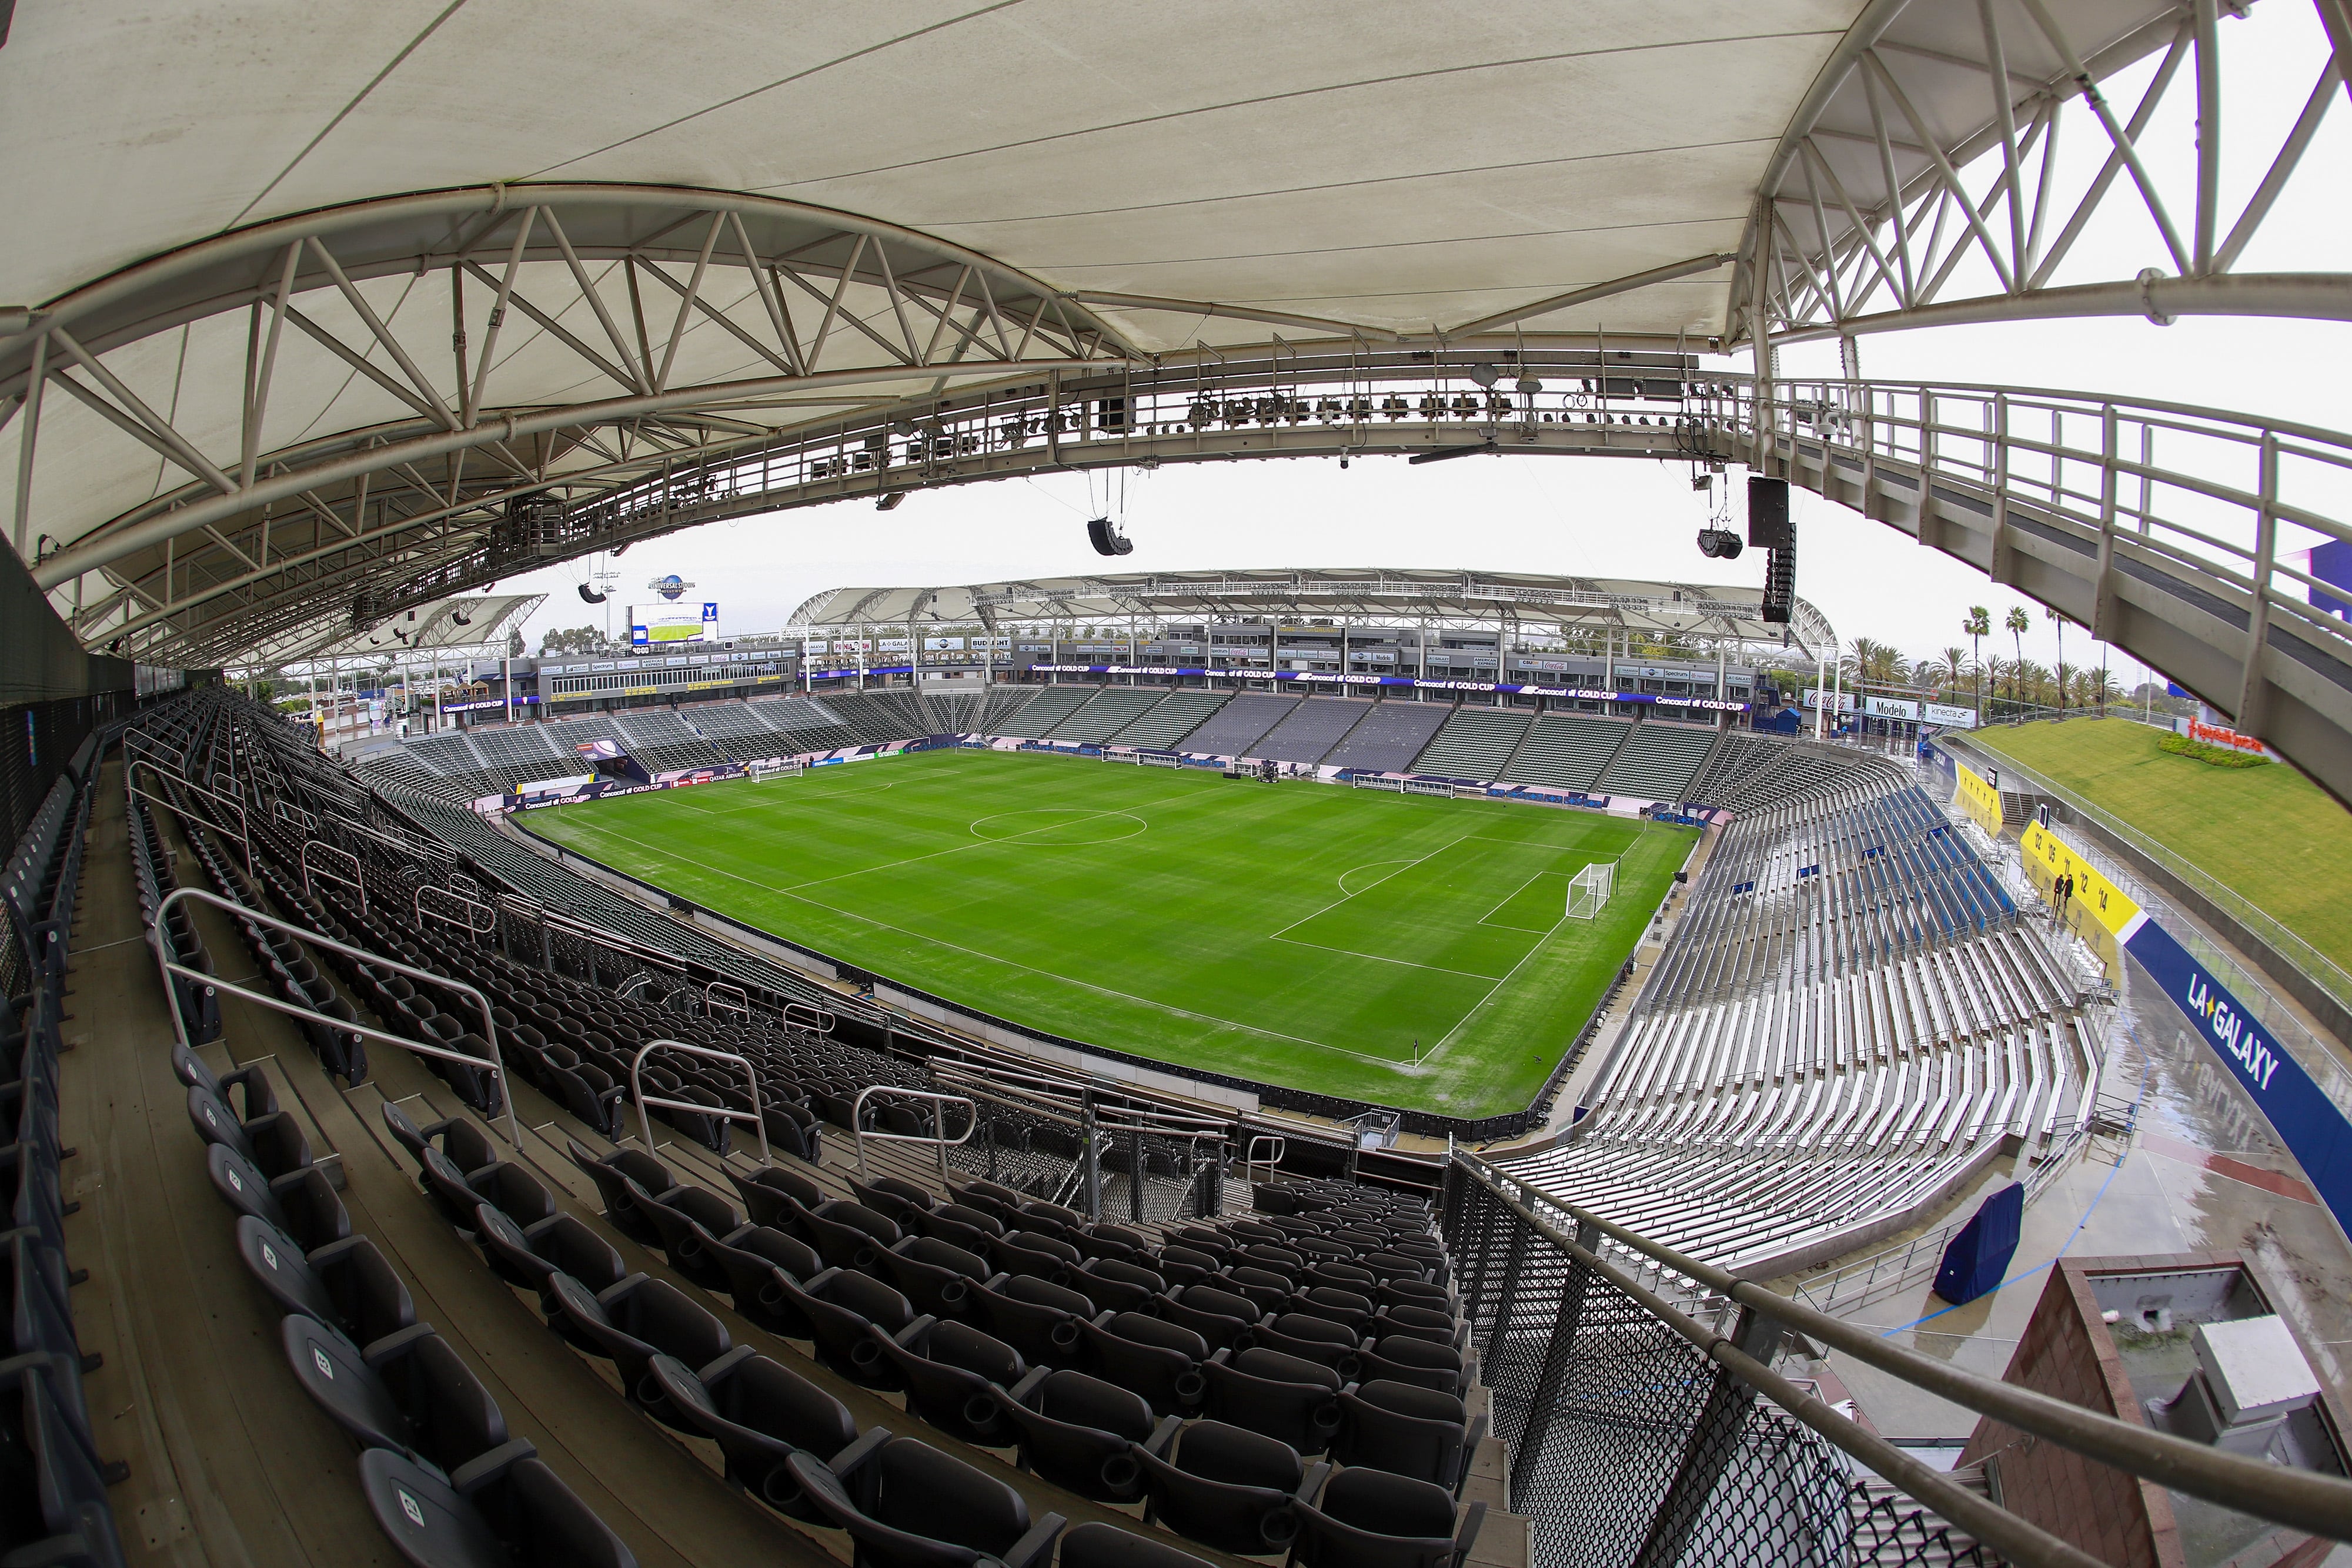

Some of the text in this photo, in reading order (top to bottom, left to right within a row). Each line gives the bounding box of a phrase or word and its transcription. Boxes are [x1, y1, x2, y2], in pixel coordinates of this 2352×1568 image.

[632, 646, 649, 654] 90:00
[1365, 676, 1381, 684] CUP
[1414, 680, 1446, 688] Concacaf
[1478, 683, 1495, 691] CUP
[1533, 688, 1618, 700] Concacaf GOLD CUP
[443, 704, 468, 713] Concacaf
[1656, 696, 1745, 711] Concacaf GOLD CUP
[1876, 701, 1906, 717] Modelo
[1931, 706, 1957, 717] kinecta
[878, 749, 899, 758] aramco
[600, 789, 626, 798] Concacaf
[633, 785, 650, 793] GOLD
[526, 800, 552, 810] Concacaf
[2099, 887, 2108, 912] '14
[2187, 972, 2280, 1091] LA GALAXY
